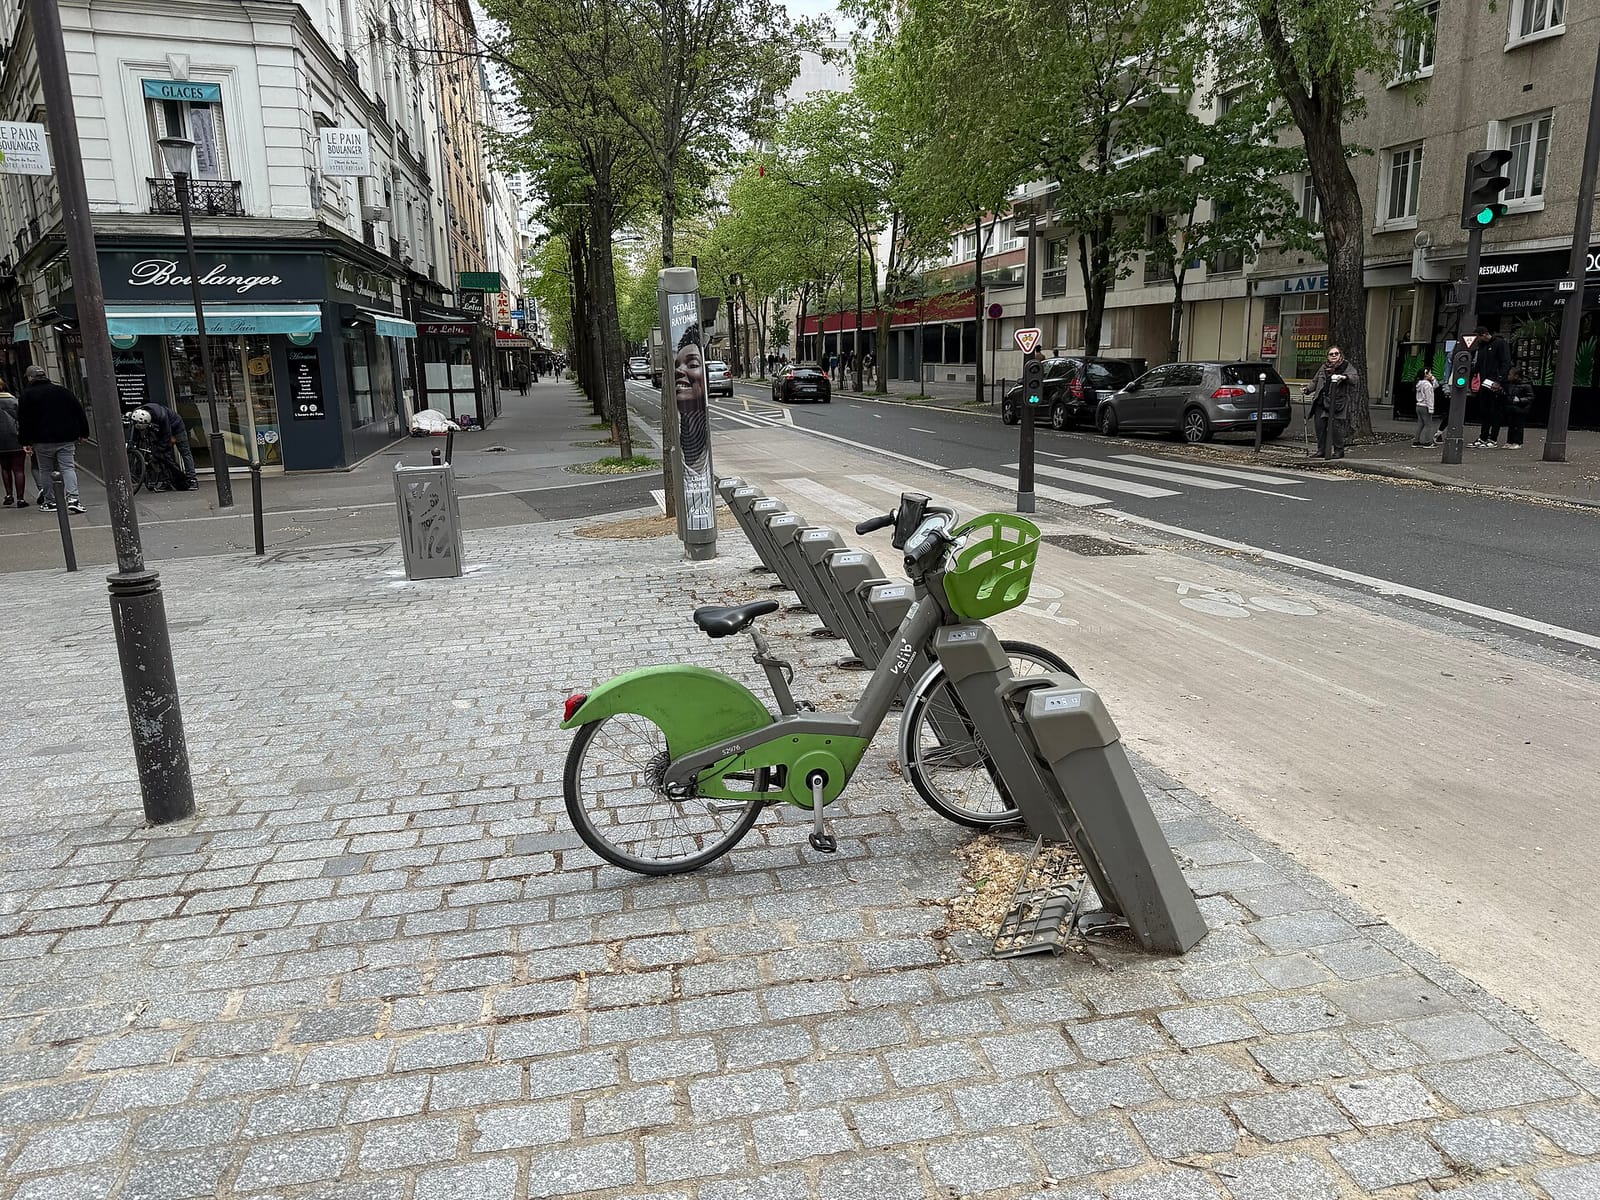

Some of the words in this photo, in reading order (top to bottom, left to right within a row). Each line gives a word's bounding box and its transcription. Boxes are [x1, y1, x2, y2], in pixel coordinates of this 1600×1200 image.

[161, 85, 204, 99] GLACES
[0, 127, 8, 139] E
[11, 127, 38, 141] PAIN
[326, 133, 337, 145] LE
[340, 133, 361, 145] PAIN
[328, 145, 363, 155] BOULANGER
[1479, 263, 1519, 276] RESTAURANT
[128, 259, 282, 294] Boulanger
[1502, 300, 1542, 308] RESTAURANT
